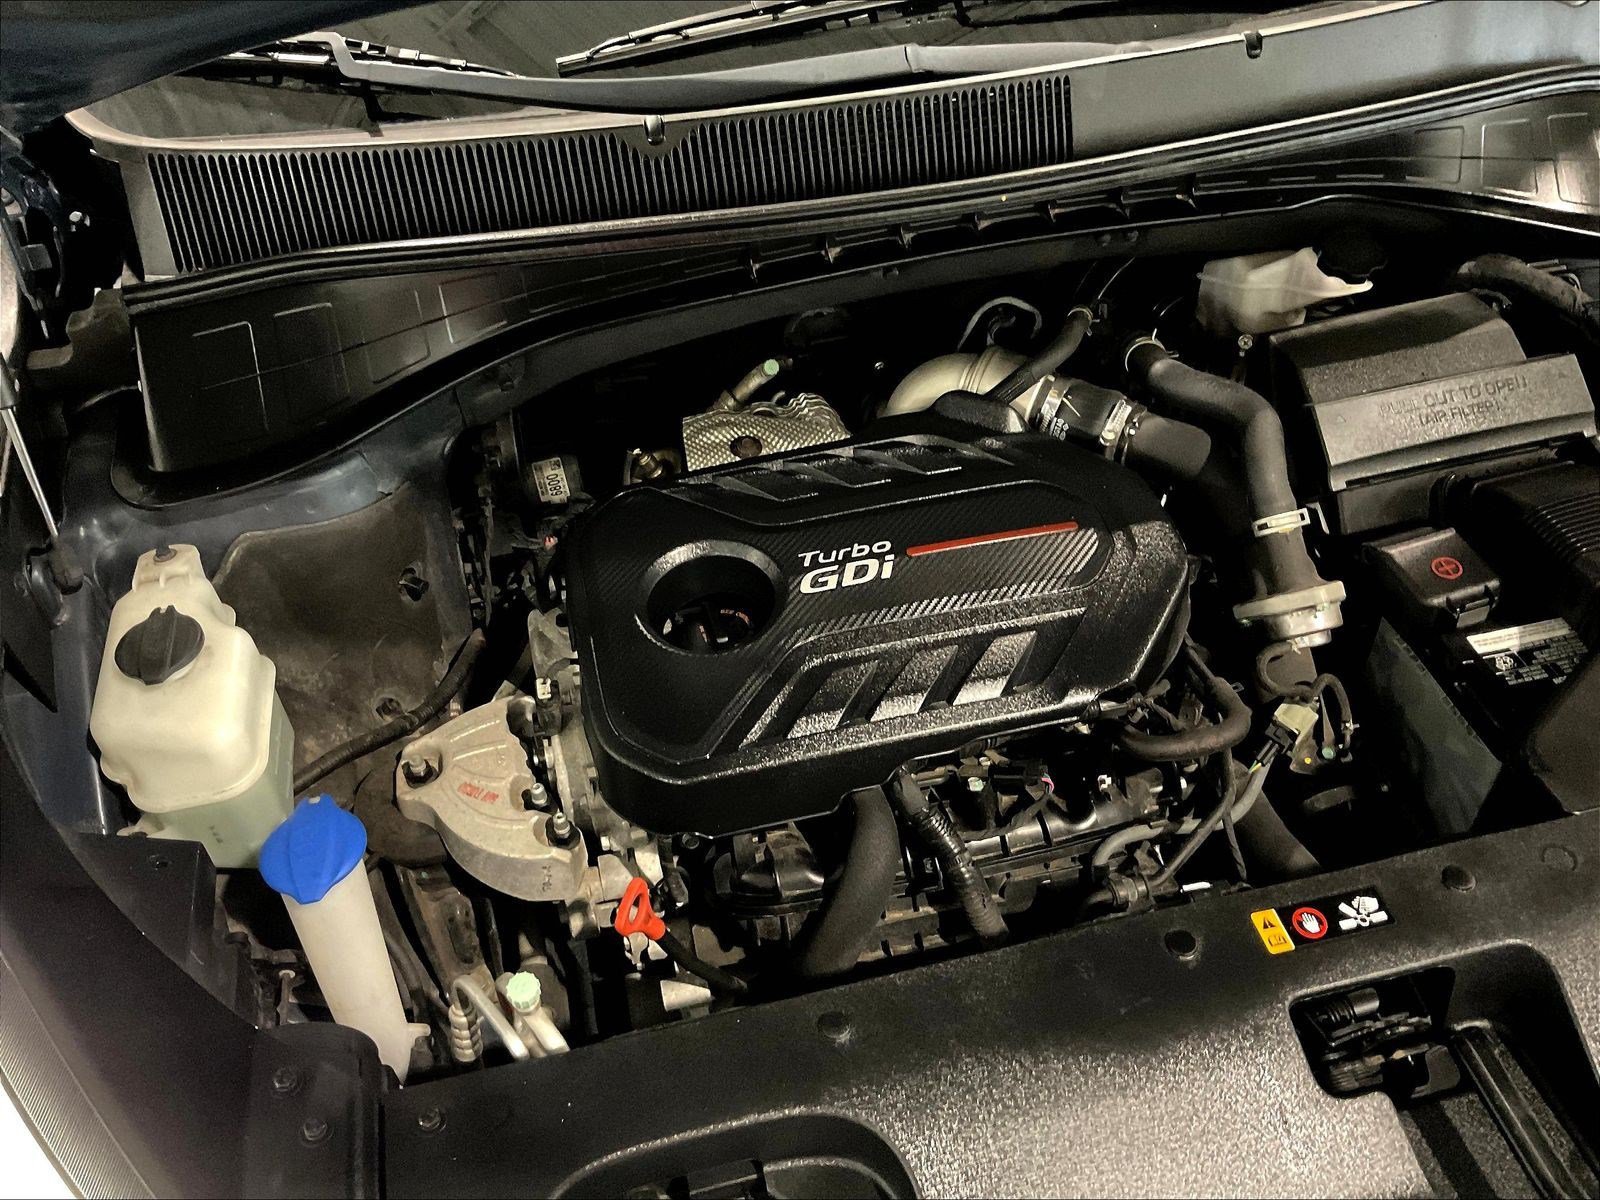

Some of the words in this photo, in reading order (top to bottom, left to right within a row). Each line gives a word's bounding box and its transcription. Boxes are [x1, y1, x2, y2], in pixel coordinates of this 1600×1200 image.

[1423, 388, 1456, 408] OUT
[1459, 383, 1482, 401] TO
[798, 540, 892, 567] Turbo
[799, 554, 895, 594] GDi
